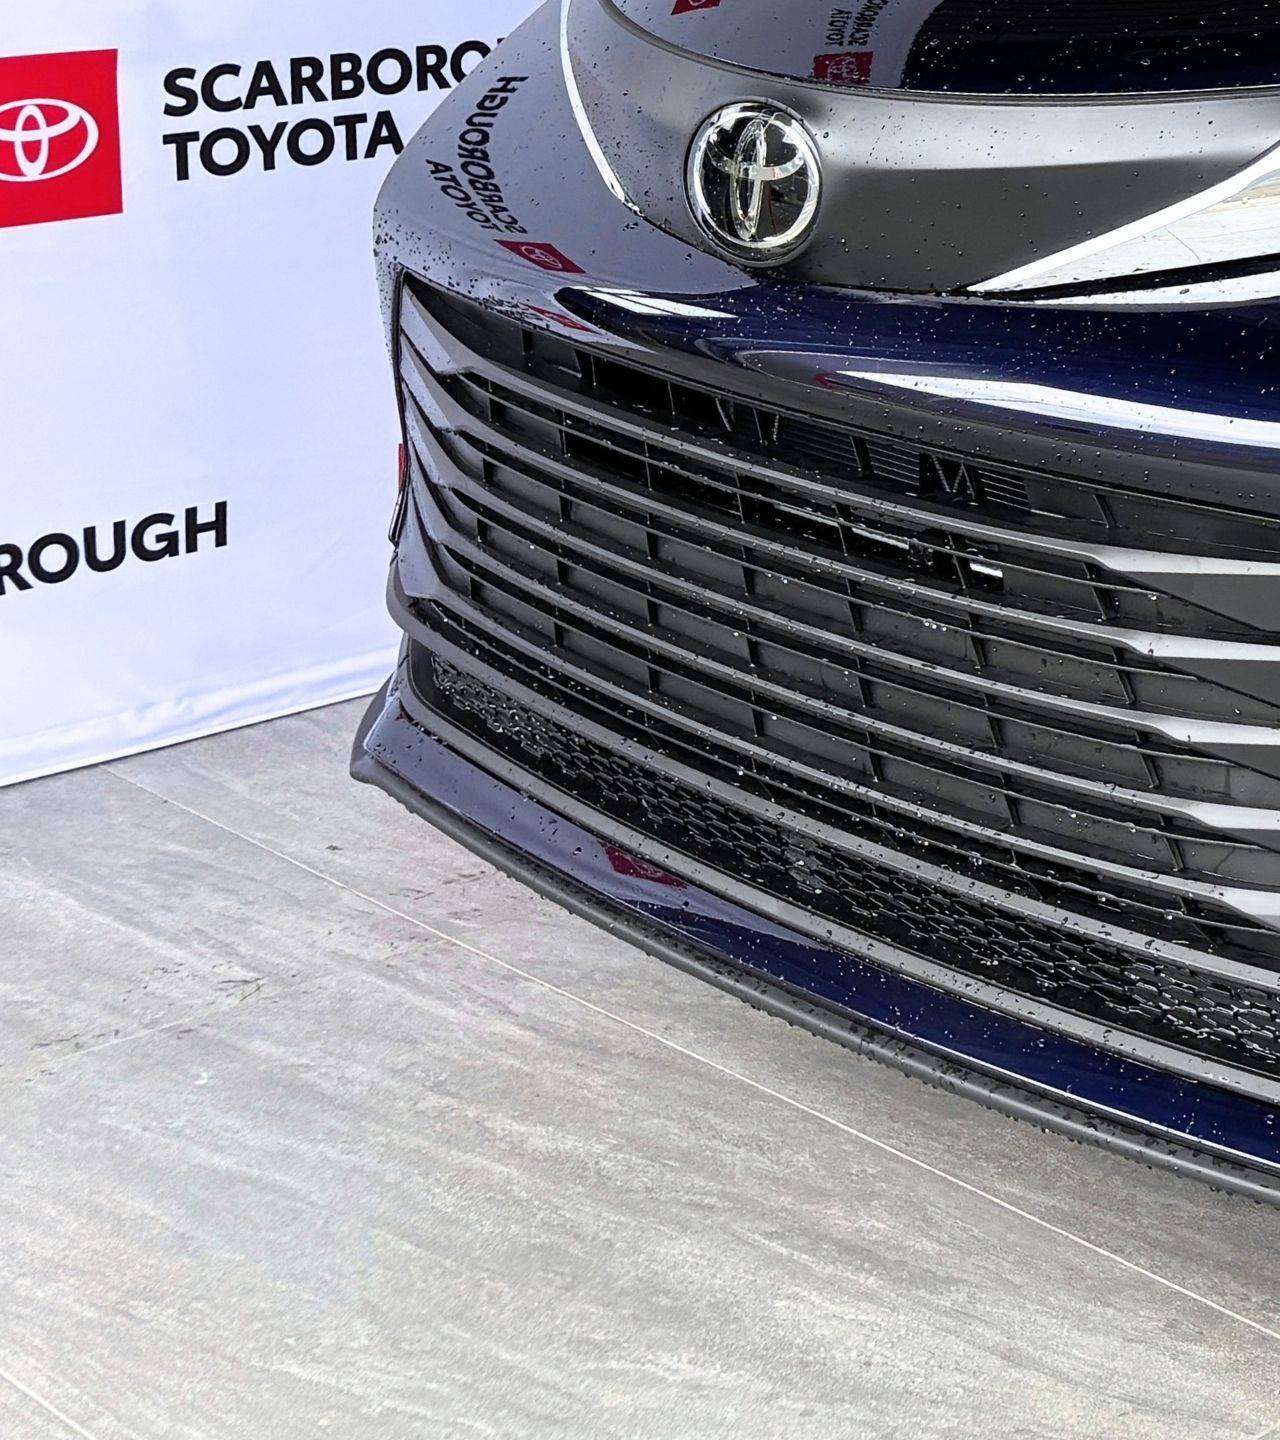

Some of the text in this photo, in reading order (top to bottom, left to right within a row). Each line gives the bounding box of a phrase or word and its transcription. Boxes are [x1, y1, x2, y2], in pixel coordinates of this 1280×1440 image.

[164, 37, 505, 117] SCARBORO
[162, 110, 406, 182] TOYOTA
[0, 500, 228, 596] ROUGH
